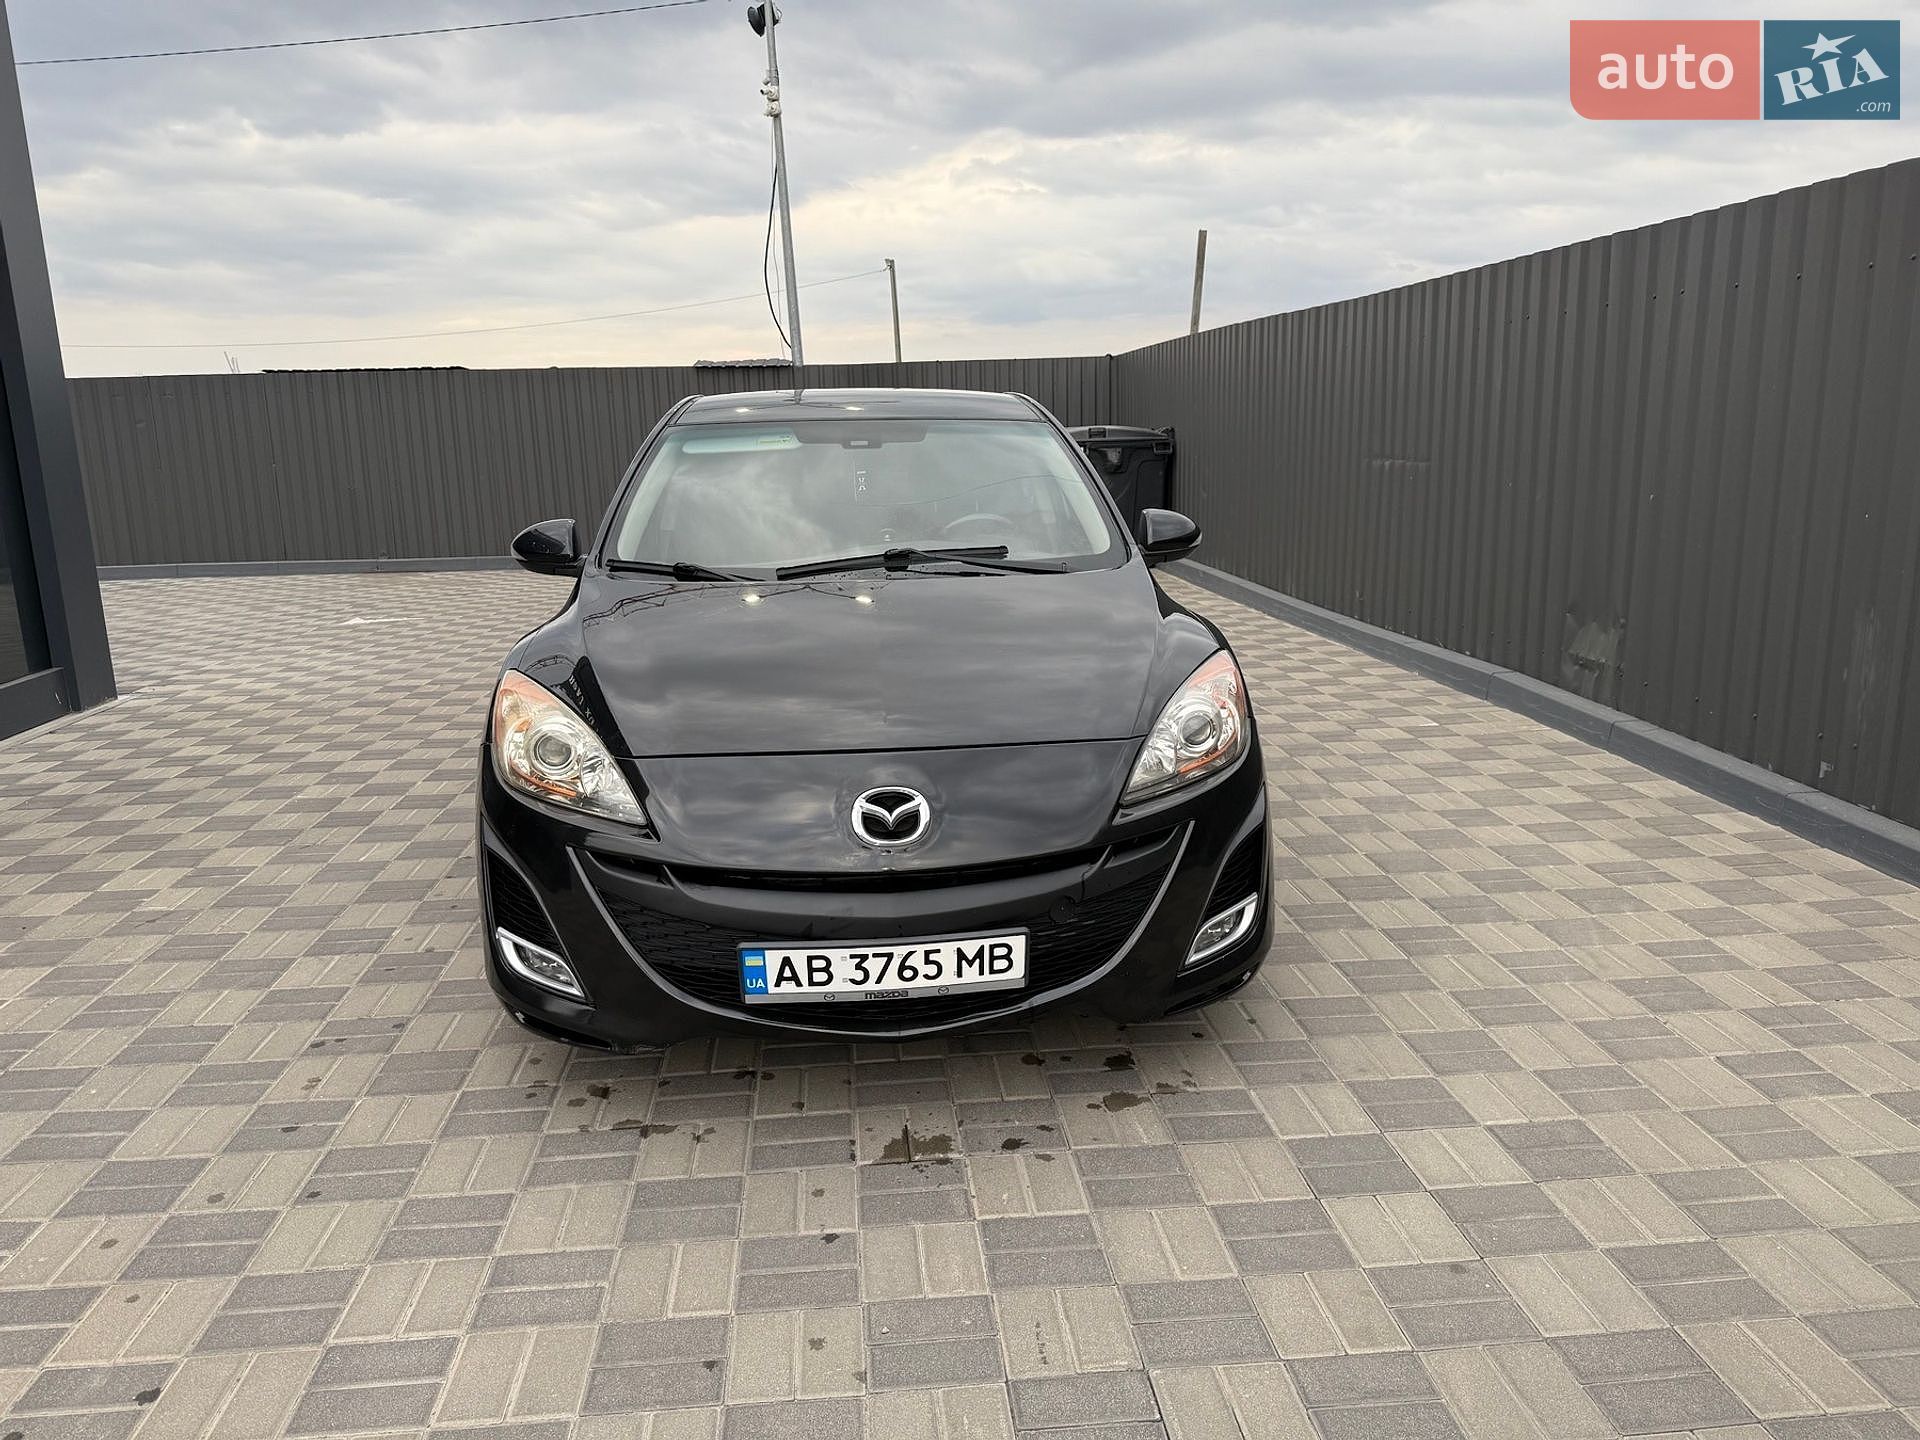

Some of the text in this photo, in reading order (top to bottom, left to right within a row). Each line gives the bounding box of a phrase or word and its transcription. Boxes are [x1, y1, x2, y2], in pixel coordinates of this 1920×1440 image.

[773, 942, 1014, 988] AB 3765 MB
[746, 977, 766, 989] UA
[863, 990, 910, 1000] mazda
